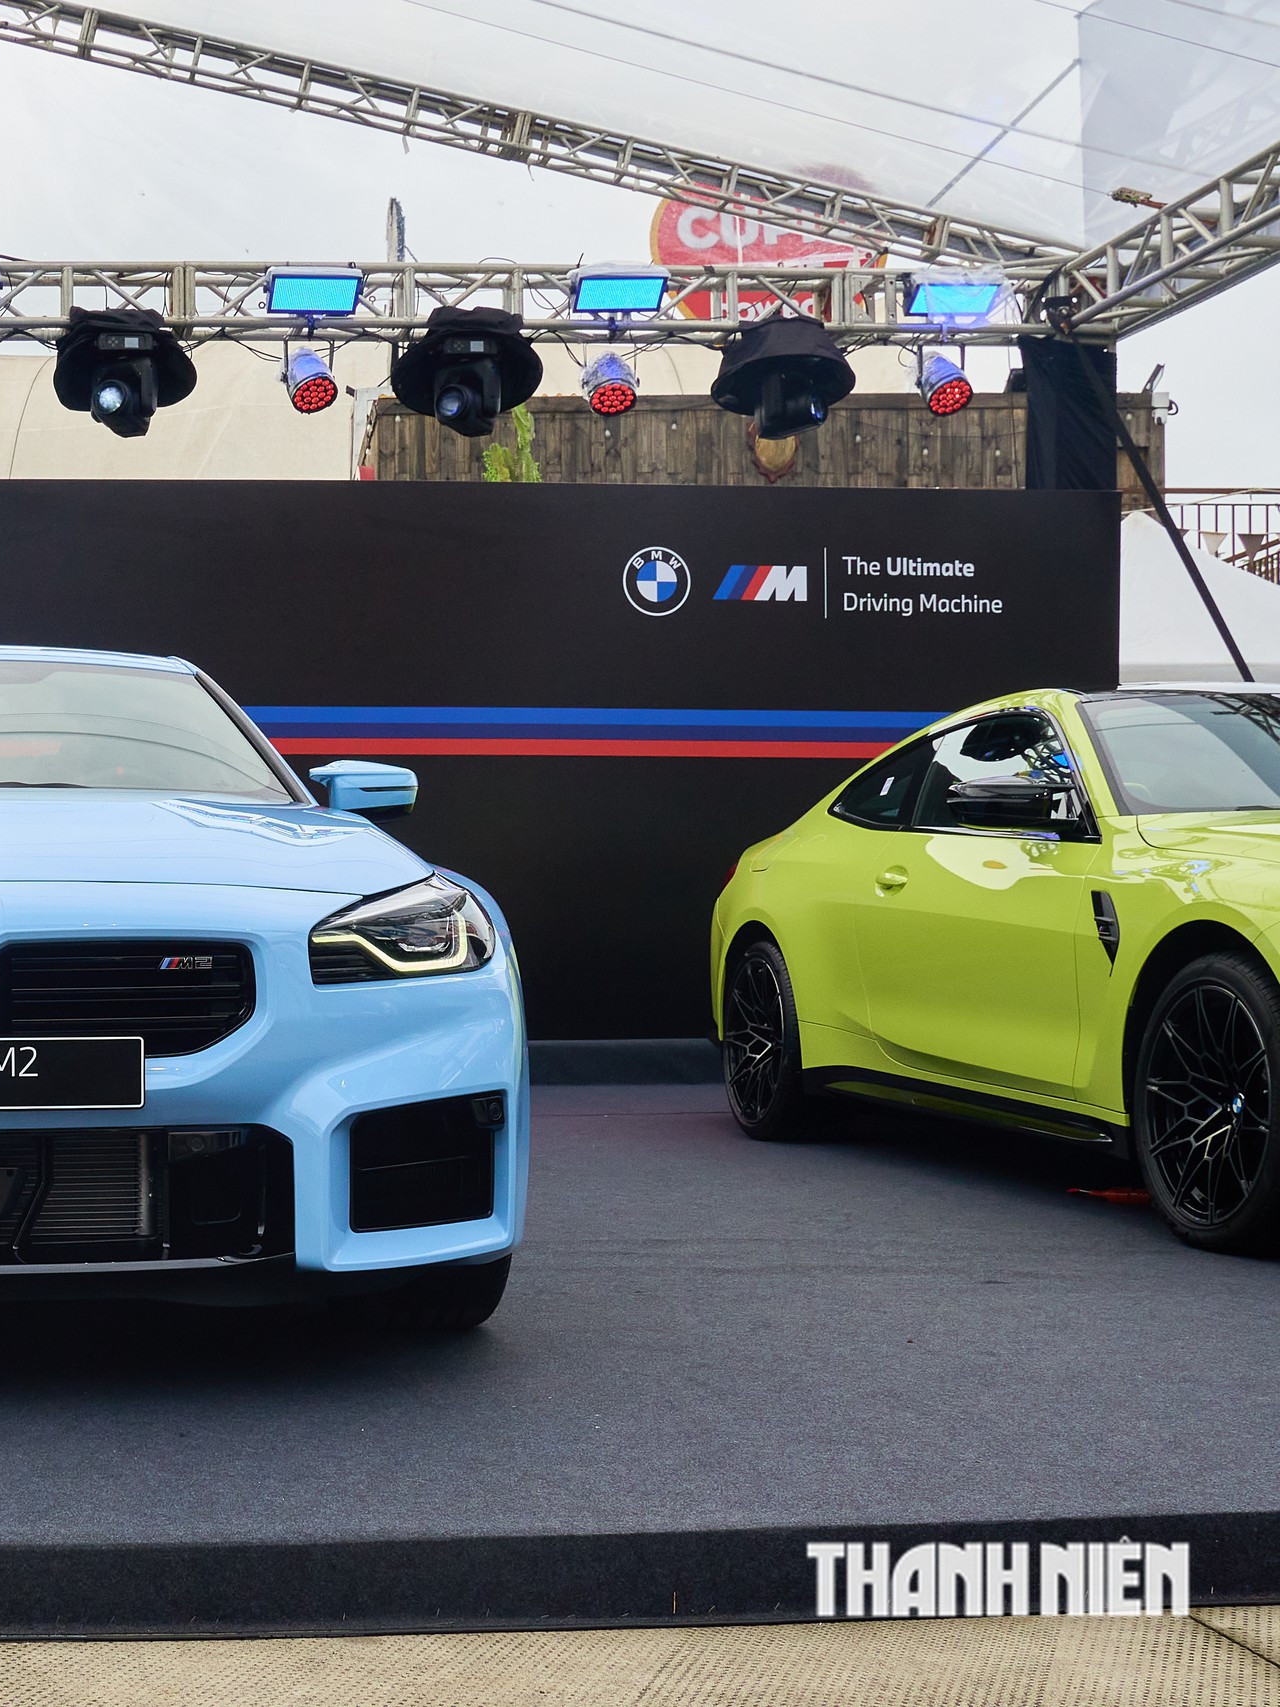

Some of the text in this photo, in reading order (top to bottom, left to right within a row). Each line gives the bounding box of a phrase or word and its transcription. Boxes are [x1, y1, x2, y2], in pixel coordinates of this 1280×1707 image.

[632, 550, 682, 570] BMW
[842, 556, 975, 577] The Ultimate
[843, 592, 1003, 617] Driving Machine
